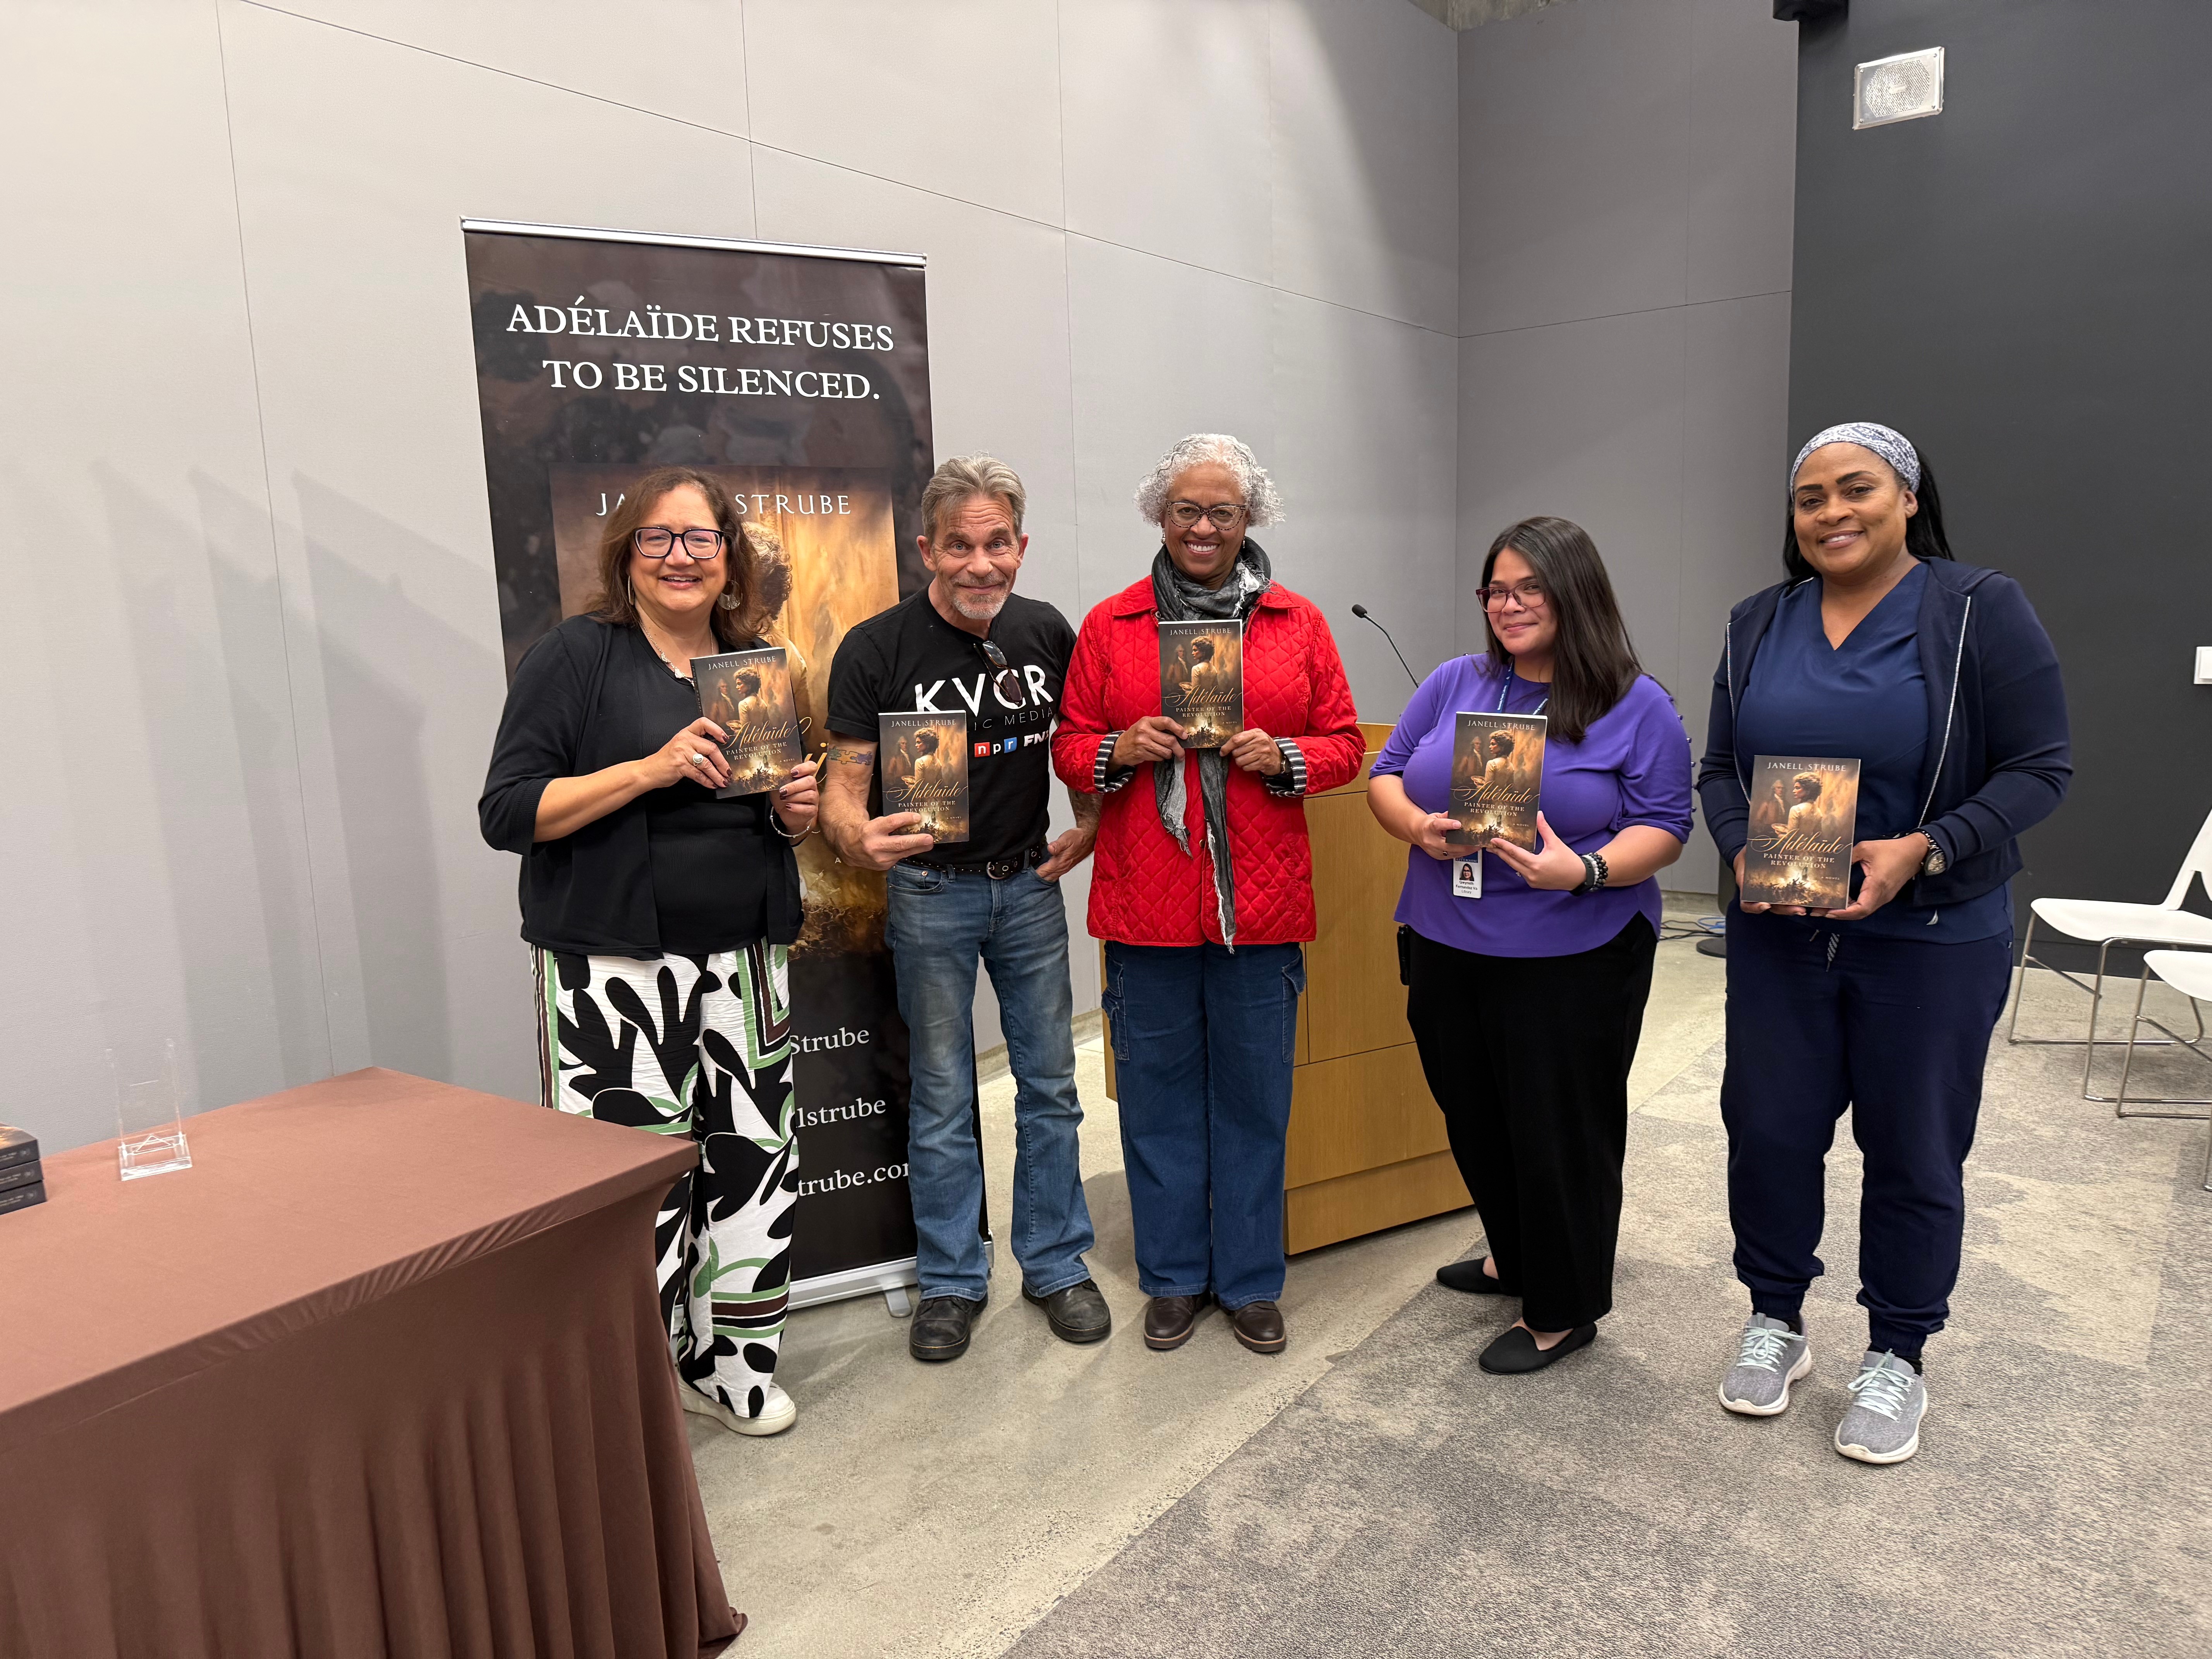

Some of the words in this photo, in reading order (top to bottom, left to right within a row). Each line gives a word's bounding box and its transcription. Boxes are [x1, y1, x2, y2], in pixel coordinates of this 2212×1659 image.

[506, 295, 719, 342] ADÉLAÏDE
[728, 316, 895, 352] REFUSES
[543, 359, 603, 390] TO
[613, 362, 667, 392] BE
[678, 365, 880, 400] SILENCED.
[735, 494, 851, 515] STRUBE
[708, 660, 740, 670] JANELL
[743, 656, 776, 665] STRUBE
[915, 665, 1054, 717] KVCR
[1162, 684, 1242, 708] Adélaïde
[1005, 707, 1053, 725] MEDIA
[1467, 720, 1498, 728] JANELL
[1502, 722, 1536, 730] STRUBE
[723, 720, 797, 750] Adélaïde
[726, 746, 758, 755] PAINTER
[734, 749, 781, 760] REVOLUTION
[977, 739, 1015, 756] npr
[883, 778, 968, 803] Adélaïde
[1450, 780, 1540, 804] Adélaïde
[1470, 808, 1517, 817] REVOLUTION
[1747, 829, 1853, 855] Adélaïde
[1771, 860, 1827, 869] REVOLUTION
[790, 1027, 870, 1055] Strube
[796, 1097, 886, 1128] lstrube
